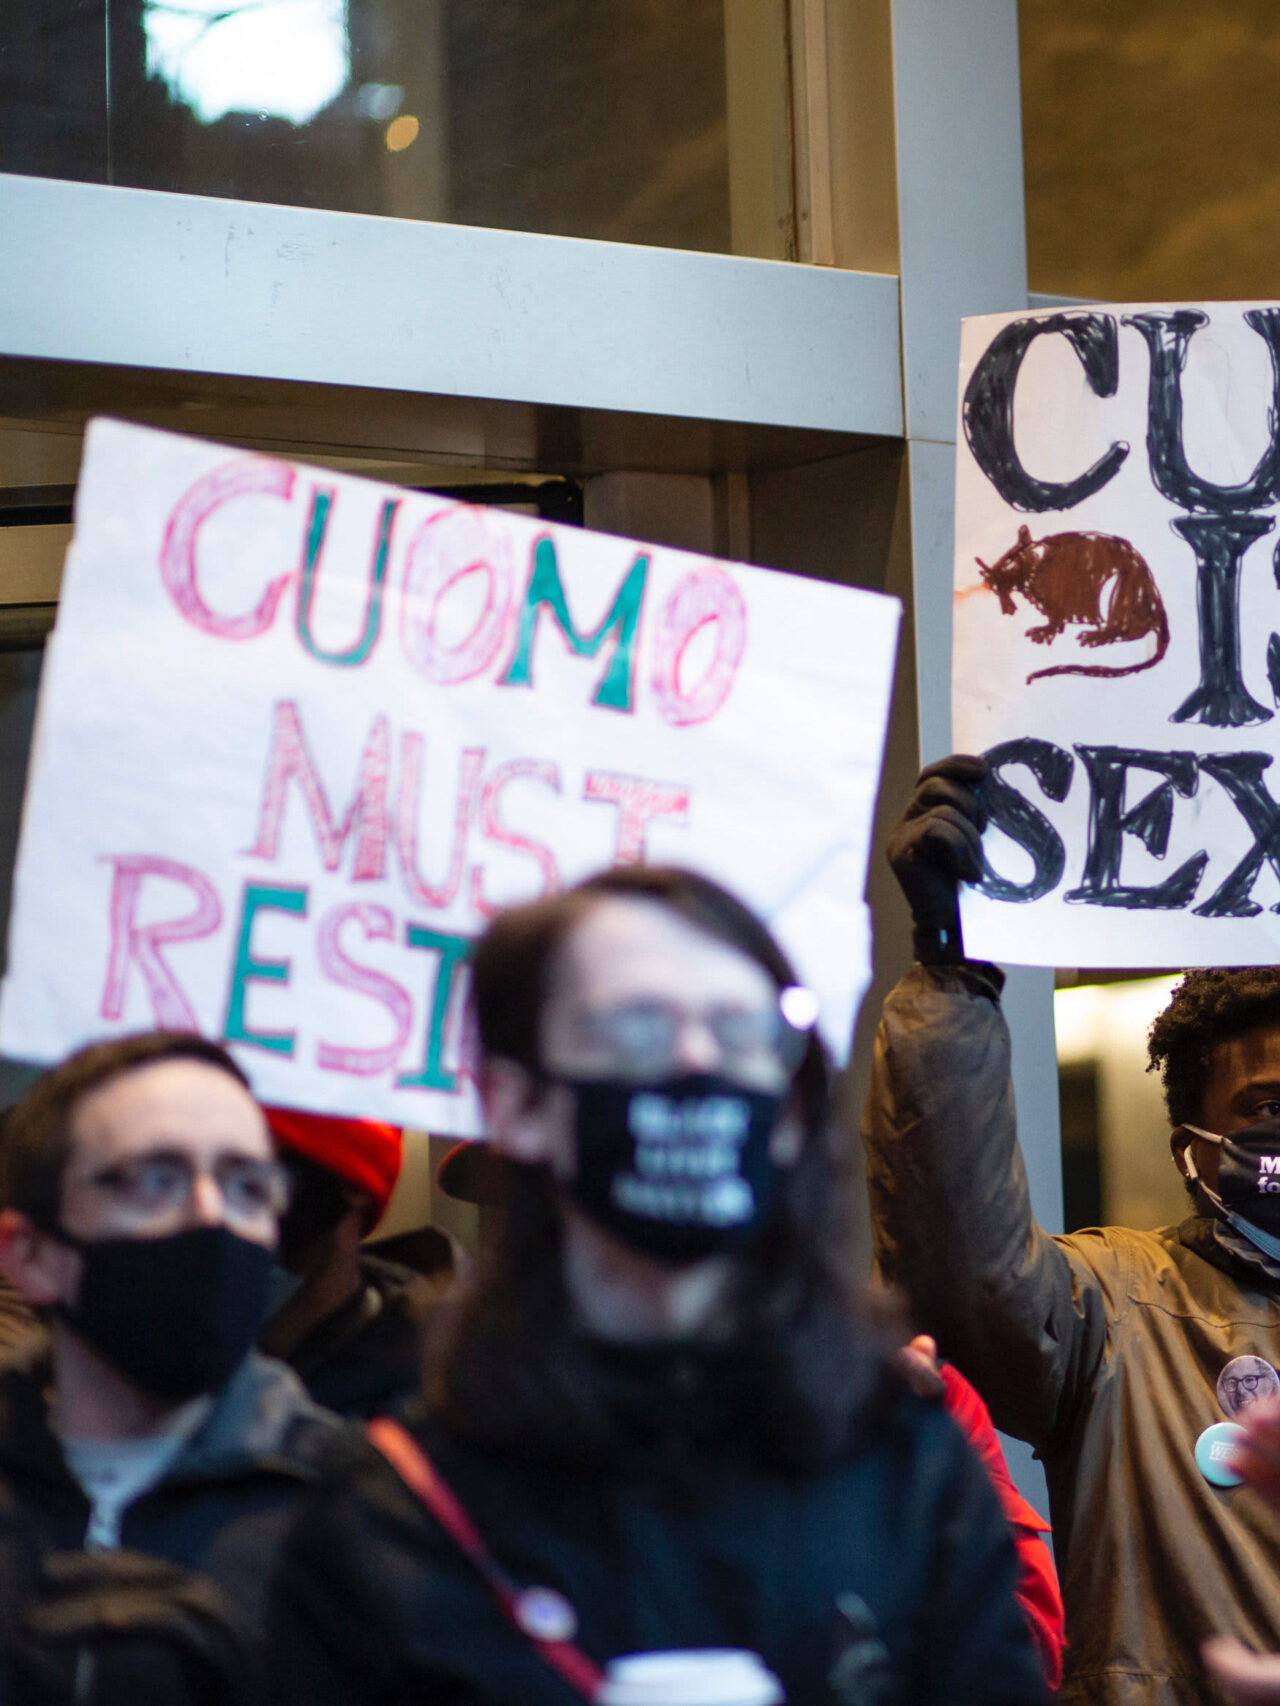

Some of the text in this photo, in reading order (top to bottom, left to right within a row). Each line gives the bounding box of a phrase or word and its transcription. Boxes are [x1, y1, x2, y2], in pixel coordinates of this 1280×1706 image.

[158, 454, 748, 728] CUOMO
[236, 699, 693, 920] MUST
[96, 852, 480, 1094] RESI
